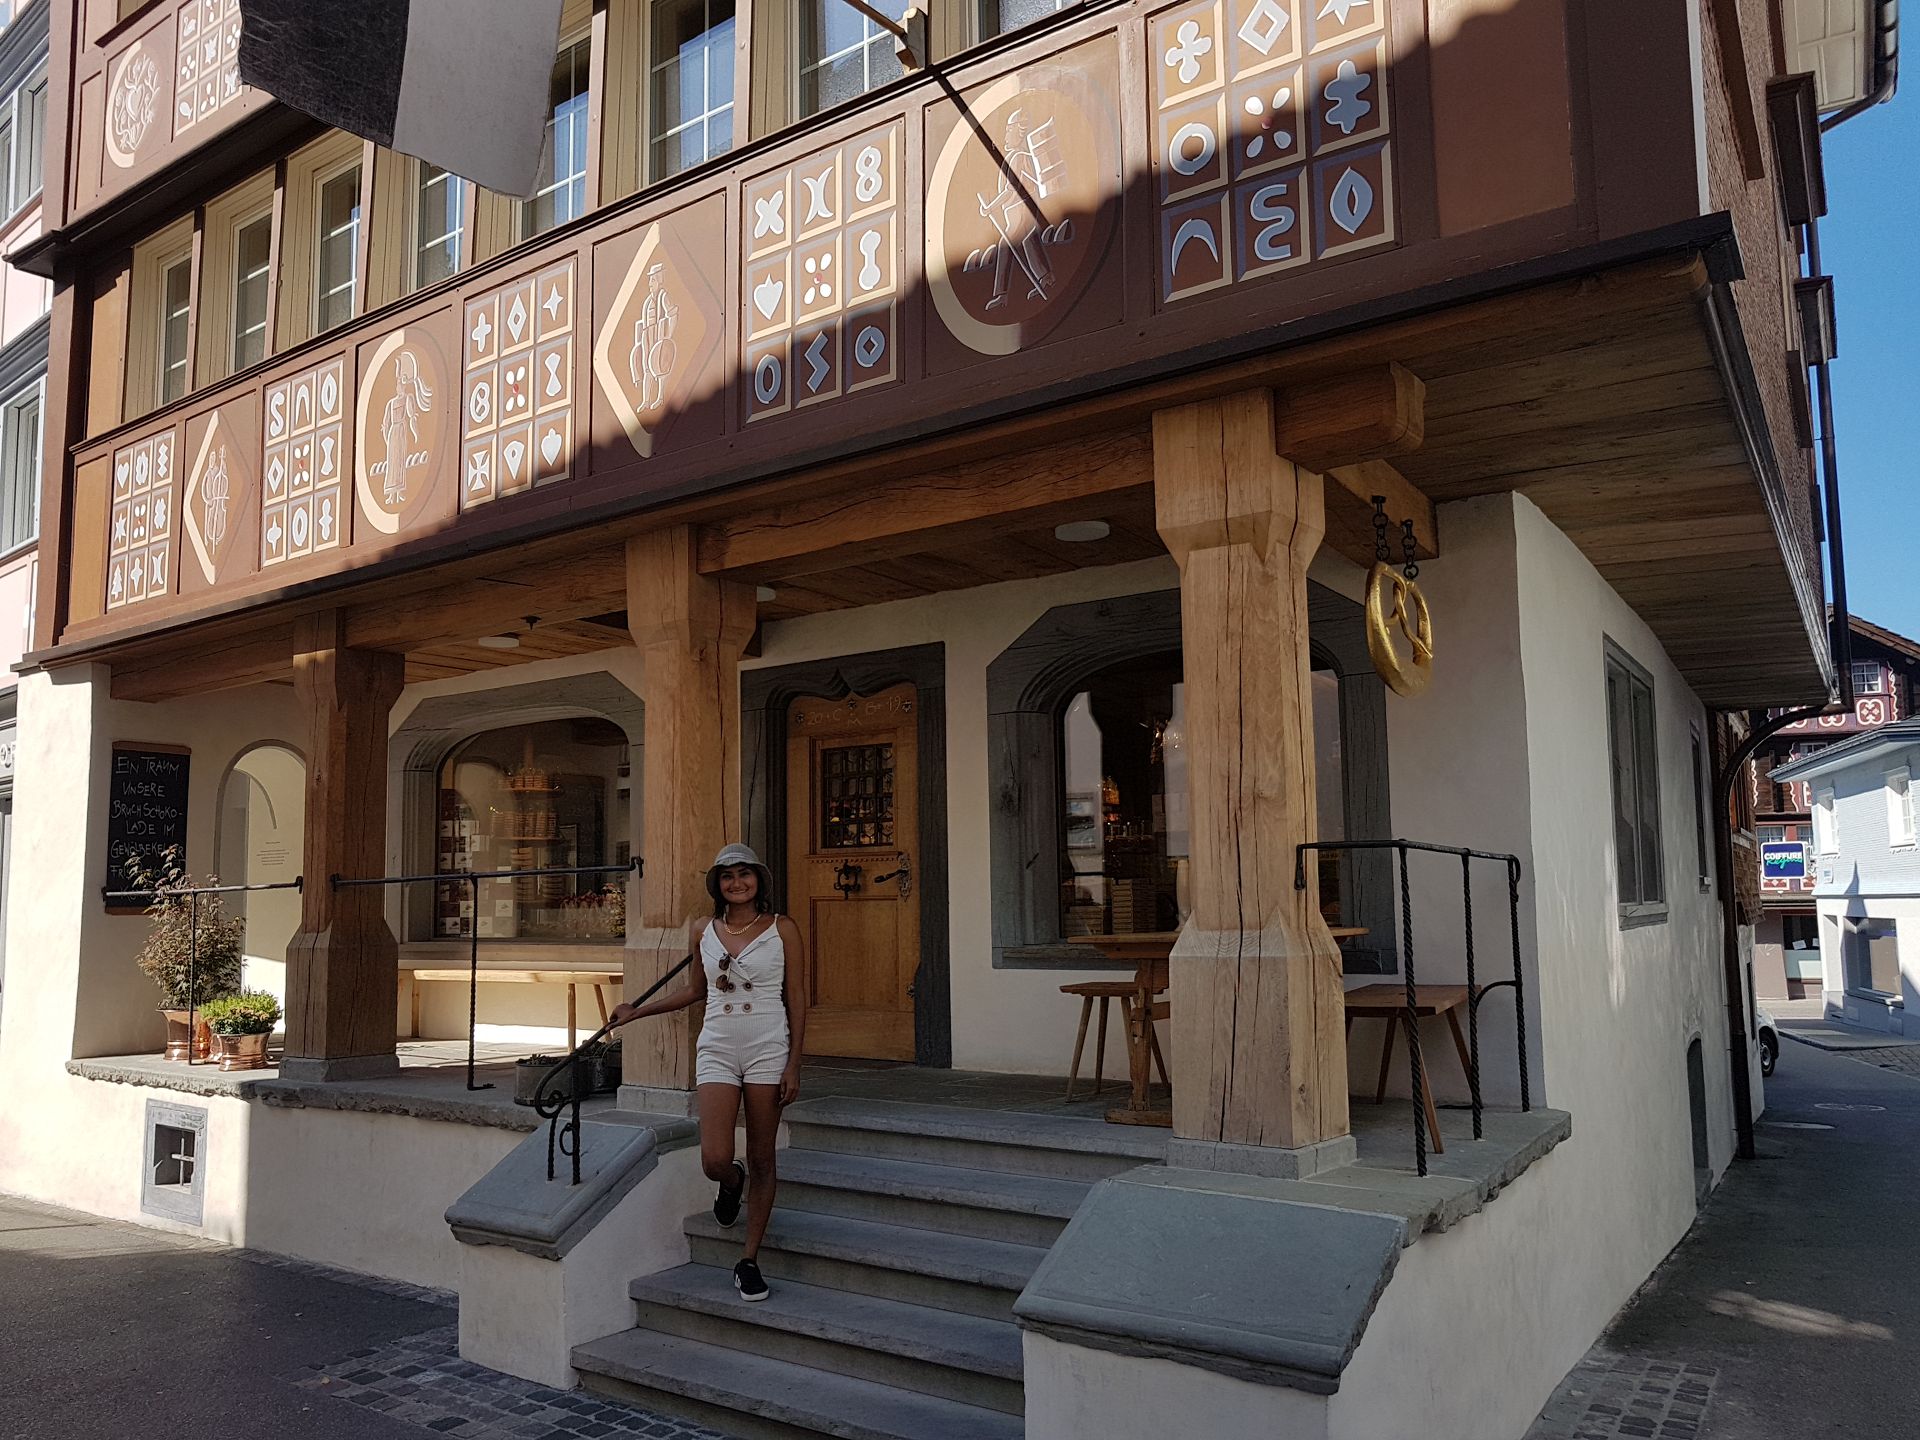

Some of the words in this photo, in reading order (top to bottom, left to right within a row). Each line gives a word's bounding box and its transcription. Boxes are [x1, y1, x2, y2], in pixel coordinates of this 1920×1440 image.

[115, 756, 139, 775] EIN
[140, 756, 180, 781] TRAUM
[122, 780, 167, 797] UNSERE
[126, 820, 156, 835] LADE
[163, 822, 176, 838] IM
[1764, 851, 1803, 860] COIFFURE
